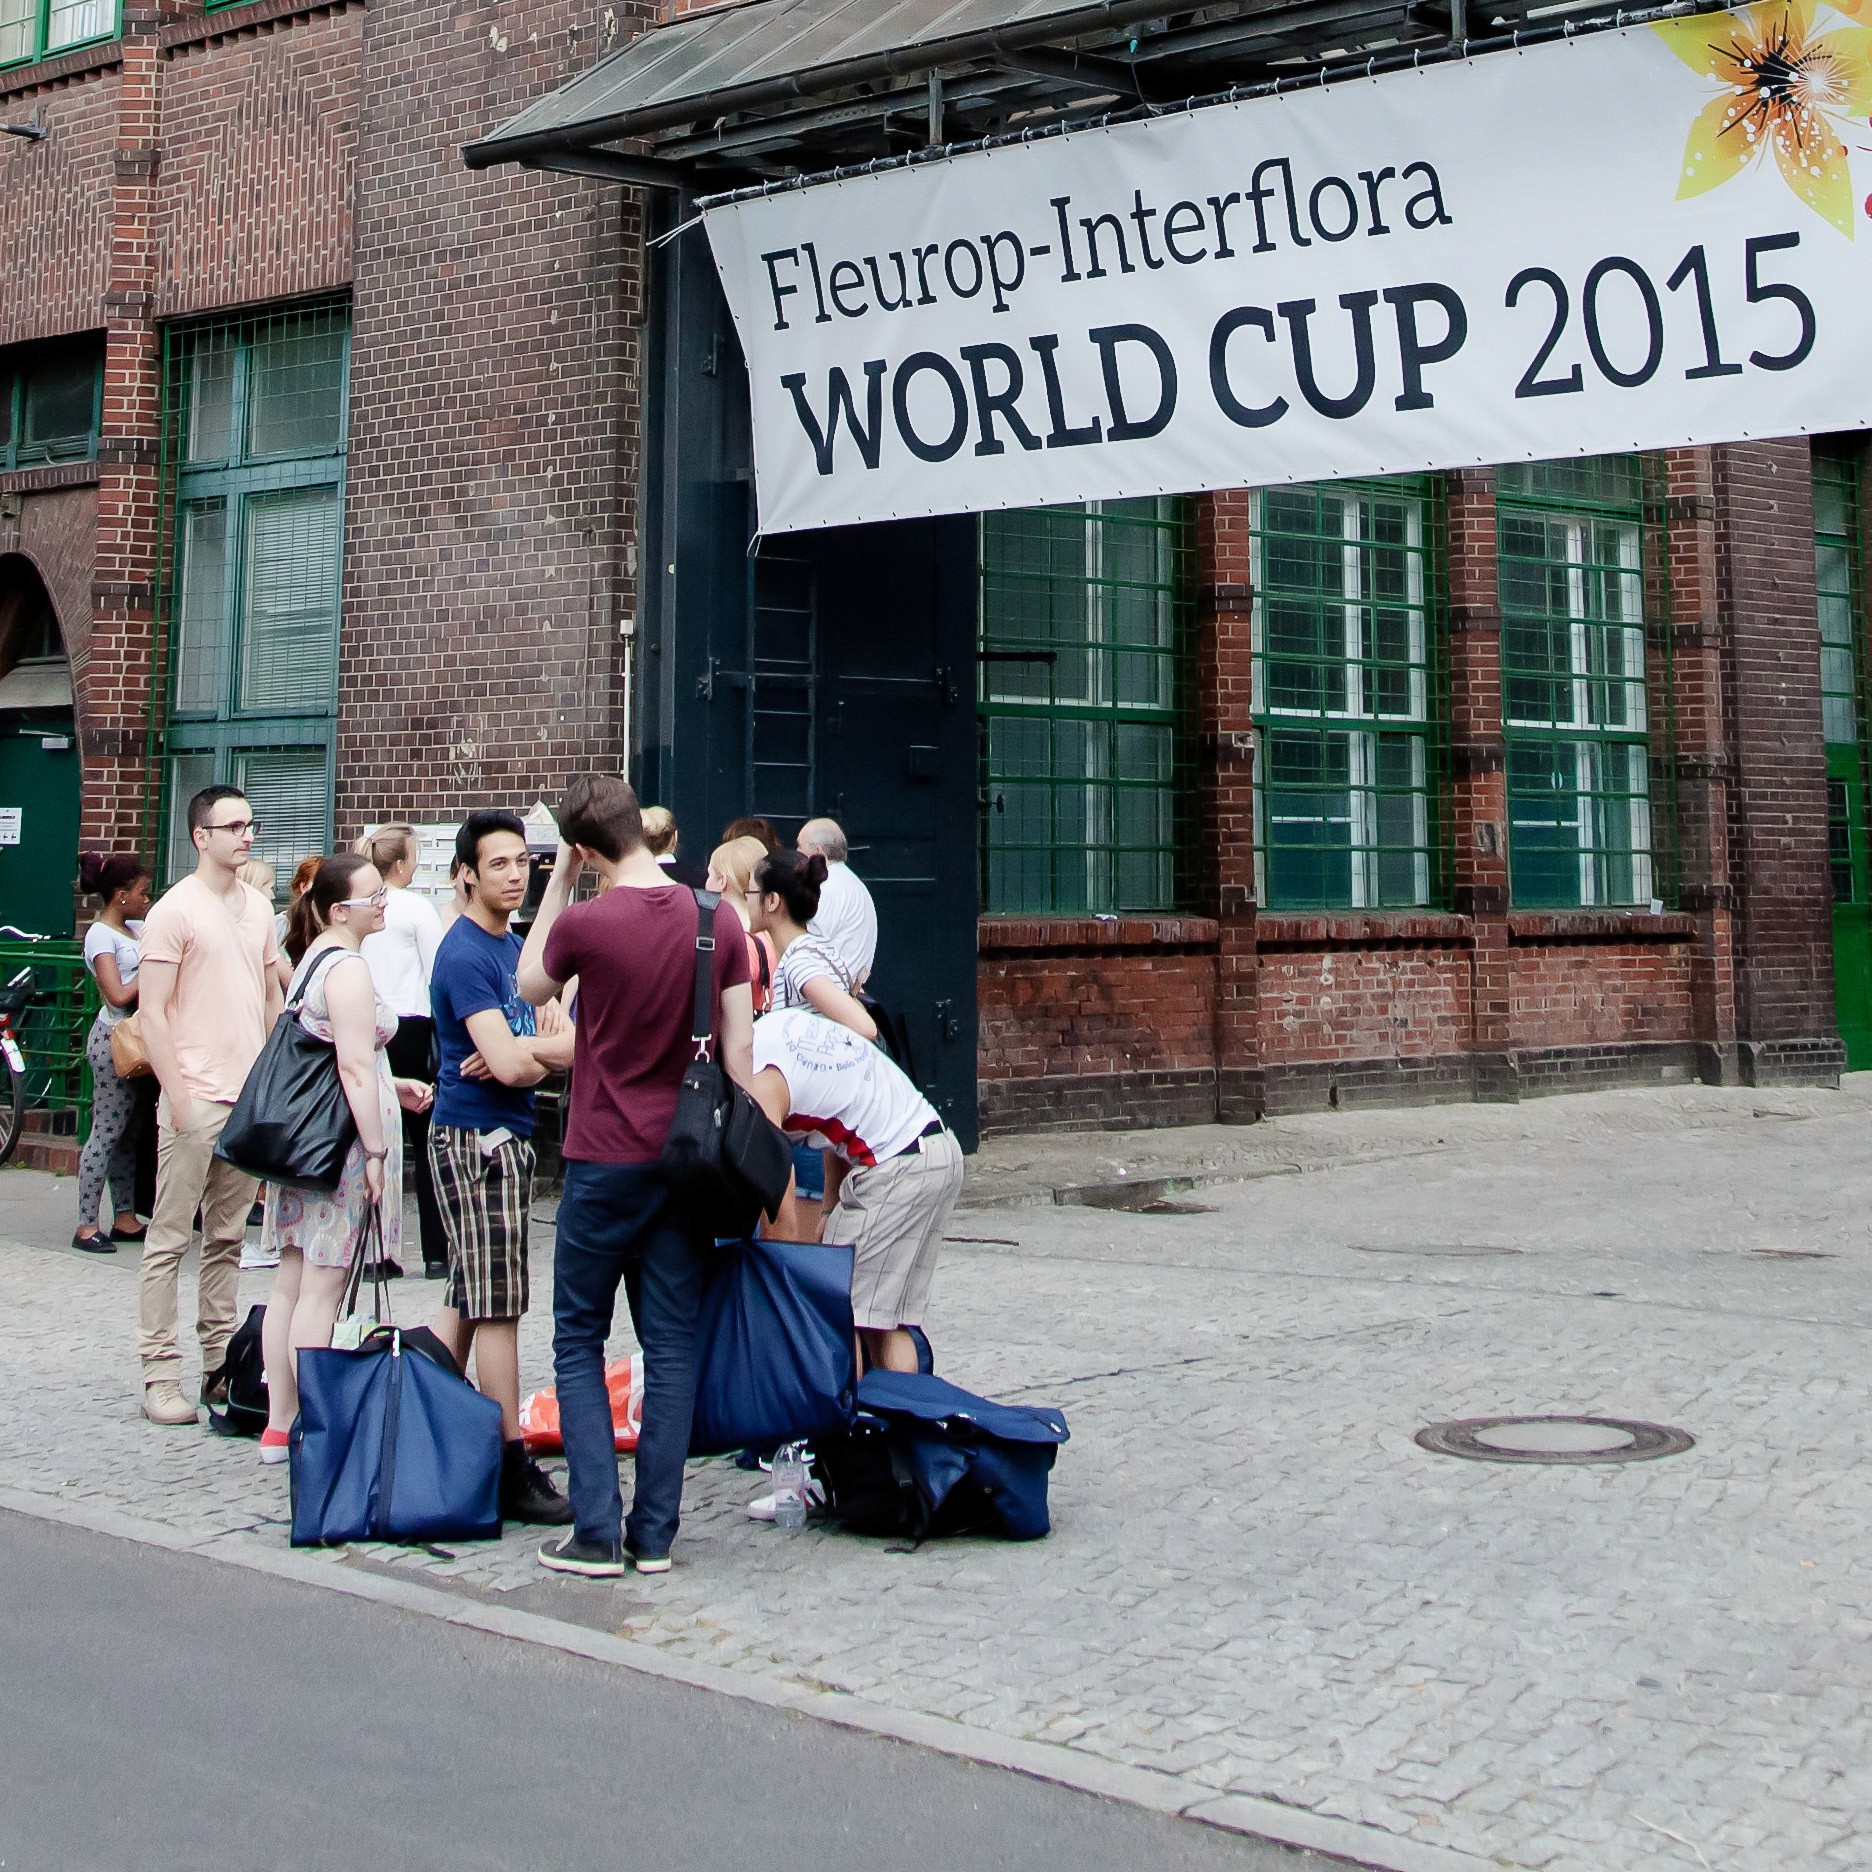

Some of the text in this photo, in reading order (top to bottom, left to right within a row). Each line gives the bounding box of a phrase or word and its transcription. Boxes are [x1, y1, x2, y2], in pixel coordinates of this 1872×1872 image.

[760, 157, 1454, 331] Fleurop-Interflora
[779, 231, 1816, 476] WORLD CUP 2015
